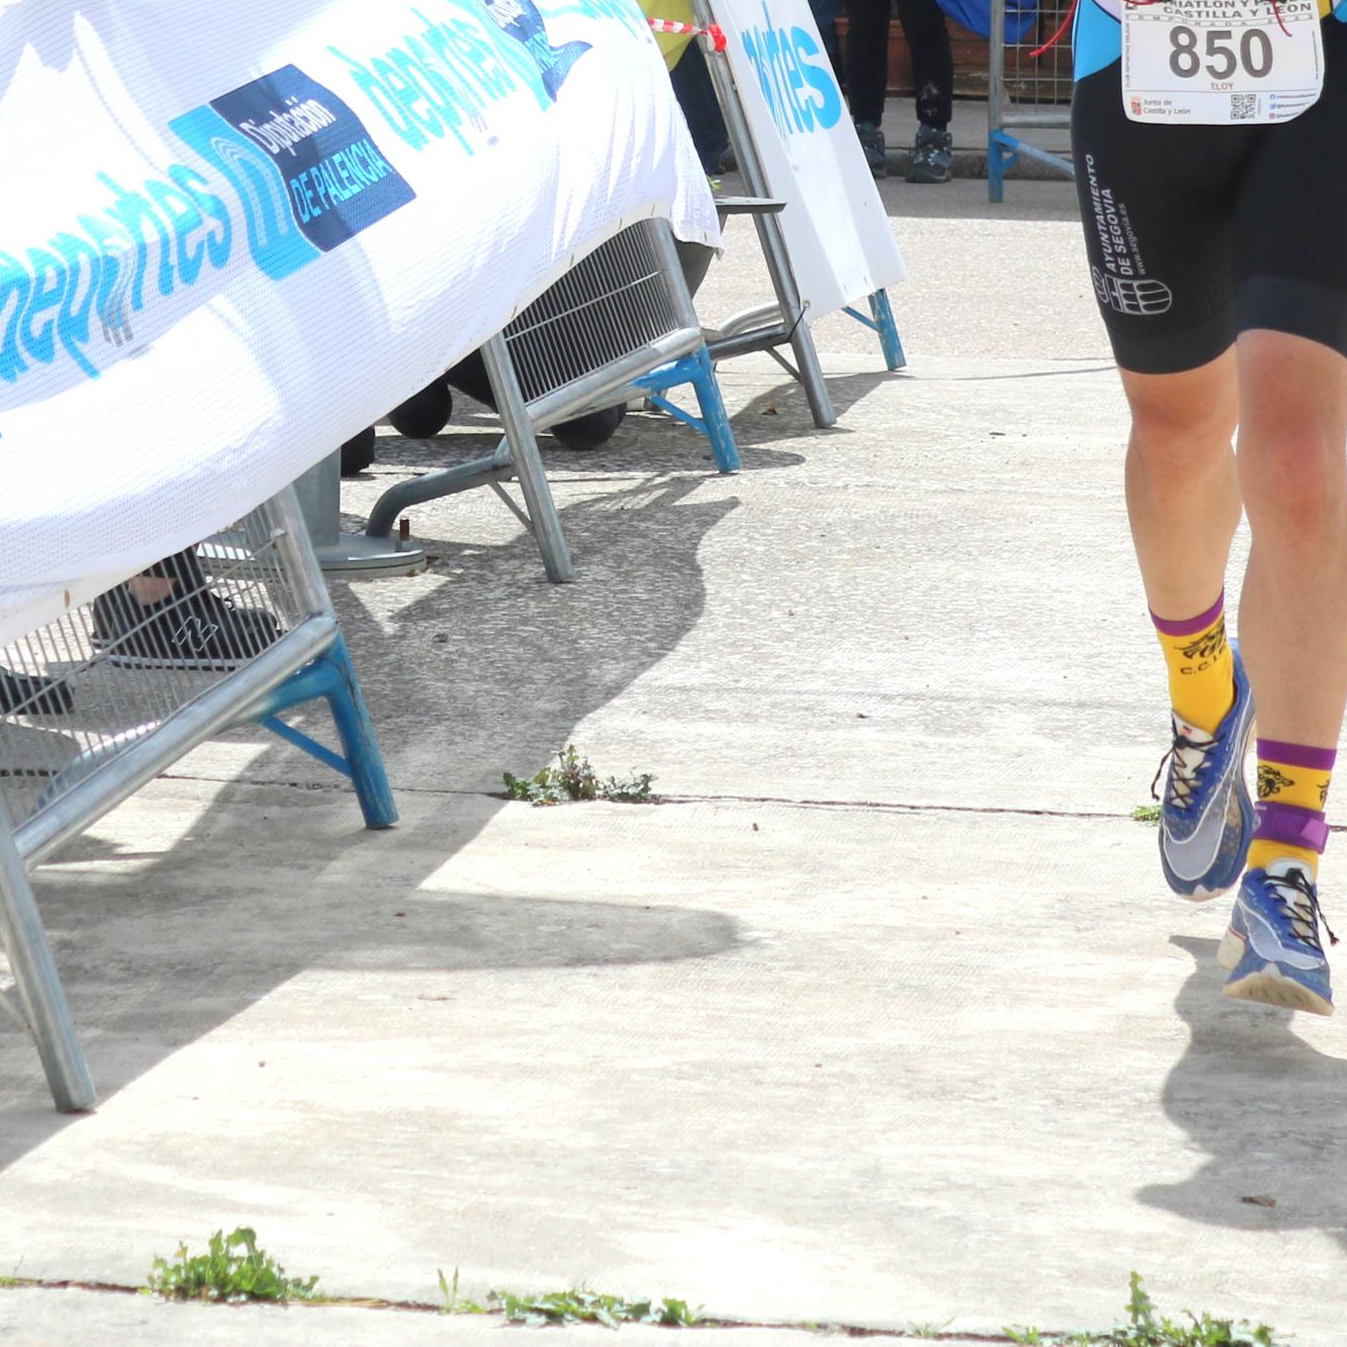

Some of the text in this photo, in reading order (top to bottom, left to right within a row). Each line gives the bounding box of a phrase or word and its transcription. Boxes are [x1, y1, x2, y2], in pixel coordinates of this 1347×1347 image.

[1164, 6, 1242, 19] CASTILLA
[1267, 4, 1311, 14] LEON
[1169, 25, 1273, 80] 850
[1211, 82, 1234, 90] ELOY
[290, 138, 393, 225] DE PALENCIA
[1085, 153, 1118, 273] AYUNTAMIENTO
[1101, 188, 1134, 276] DE SEGOVIA
